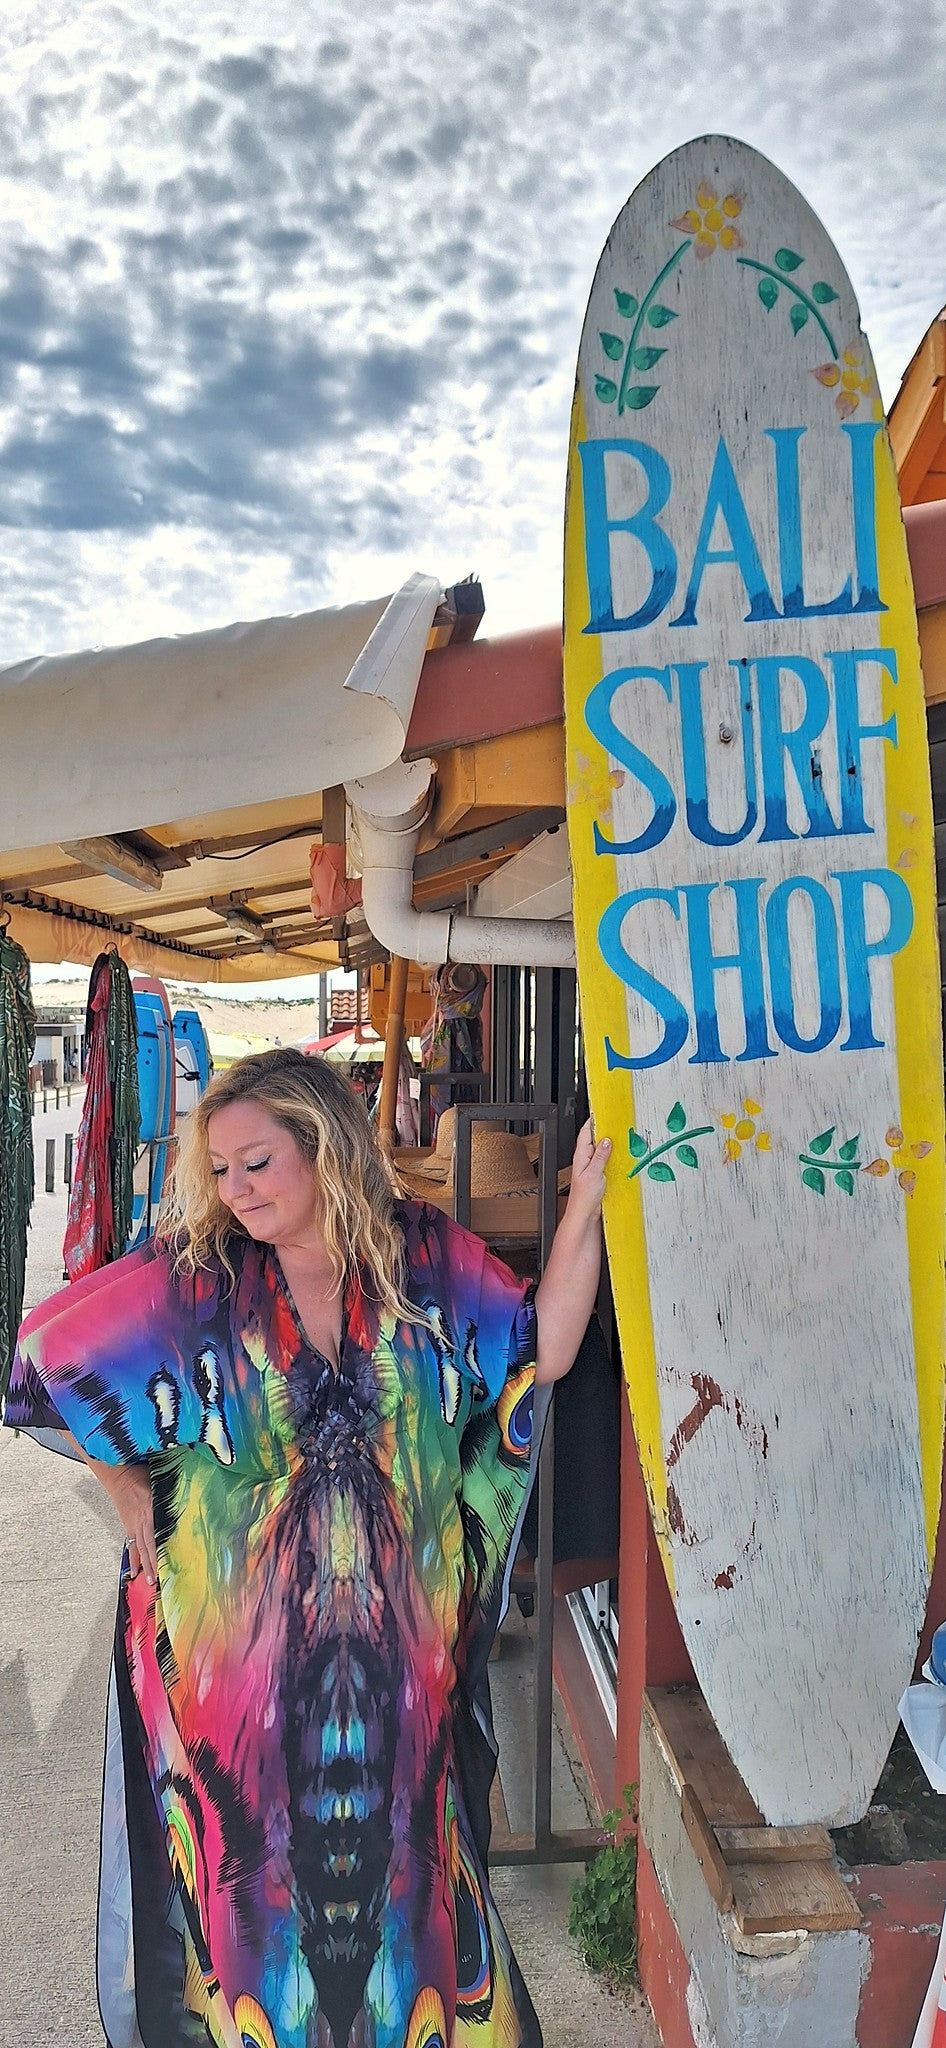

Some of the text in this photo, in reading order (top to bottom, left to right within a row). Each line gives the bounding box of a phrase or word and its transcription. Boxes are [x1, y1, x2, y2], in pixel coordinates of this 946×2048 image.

[578, 422, 889, 633] BALI
[585, 648, 898, 855] SURF
[598, 868, 913, 1070] SHOP
